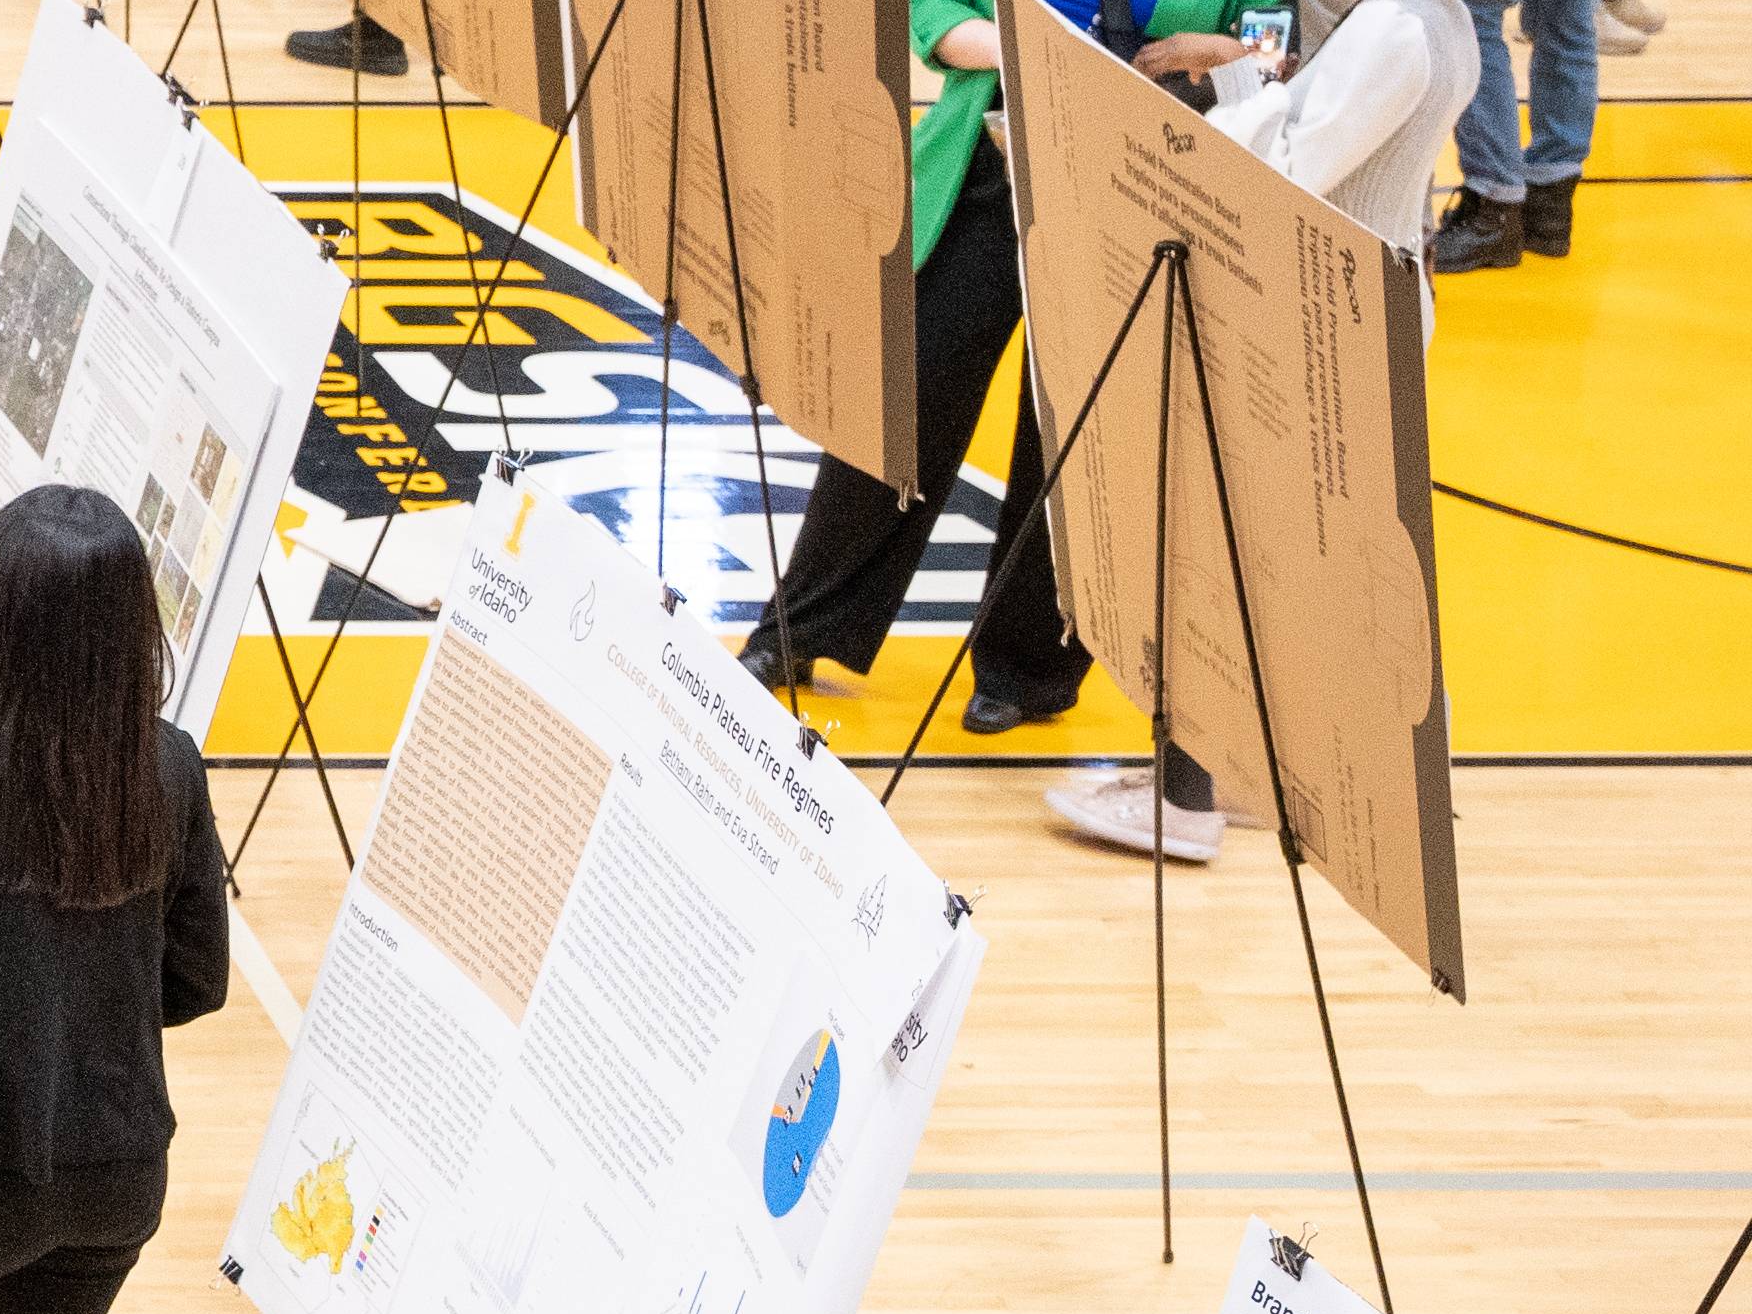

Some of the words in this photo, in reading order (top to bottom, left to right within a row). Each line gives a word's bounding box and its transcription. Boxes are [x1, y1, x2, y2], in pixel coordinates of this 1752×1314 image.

[1322, 233, 1337, 307] Tri-Fold
[1337, 247, 1362, 324] Pacon
[1327, 310, 1343, 434] Presentation
[1335, 439, 1350, 500] Board
[469, 584, 481, 600] of
[480, 583, 517, 623] Idaho
[472, 547, 532, 612] University
[449, 609, 488, 646] Abstract
[660, 640, 710, 709] Columbia
[709, 692, 755, 754] Plateau
[753, 738, 781, 781] Fire
[781, 765, 834, 835] Regimes
